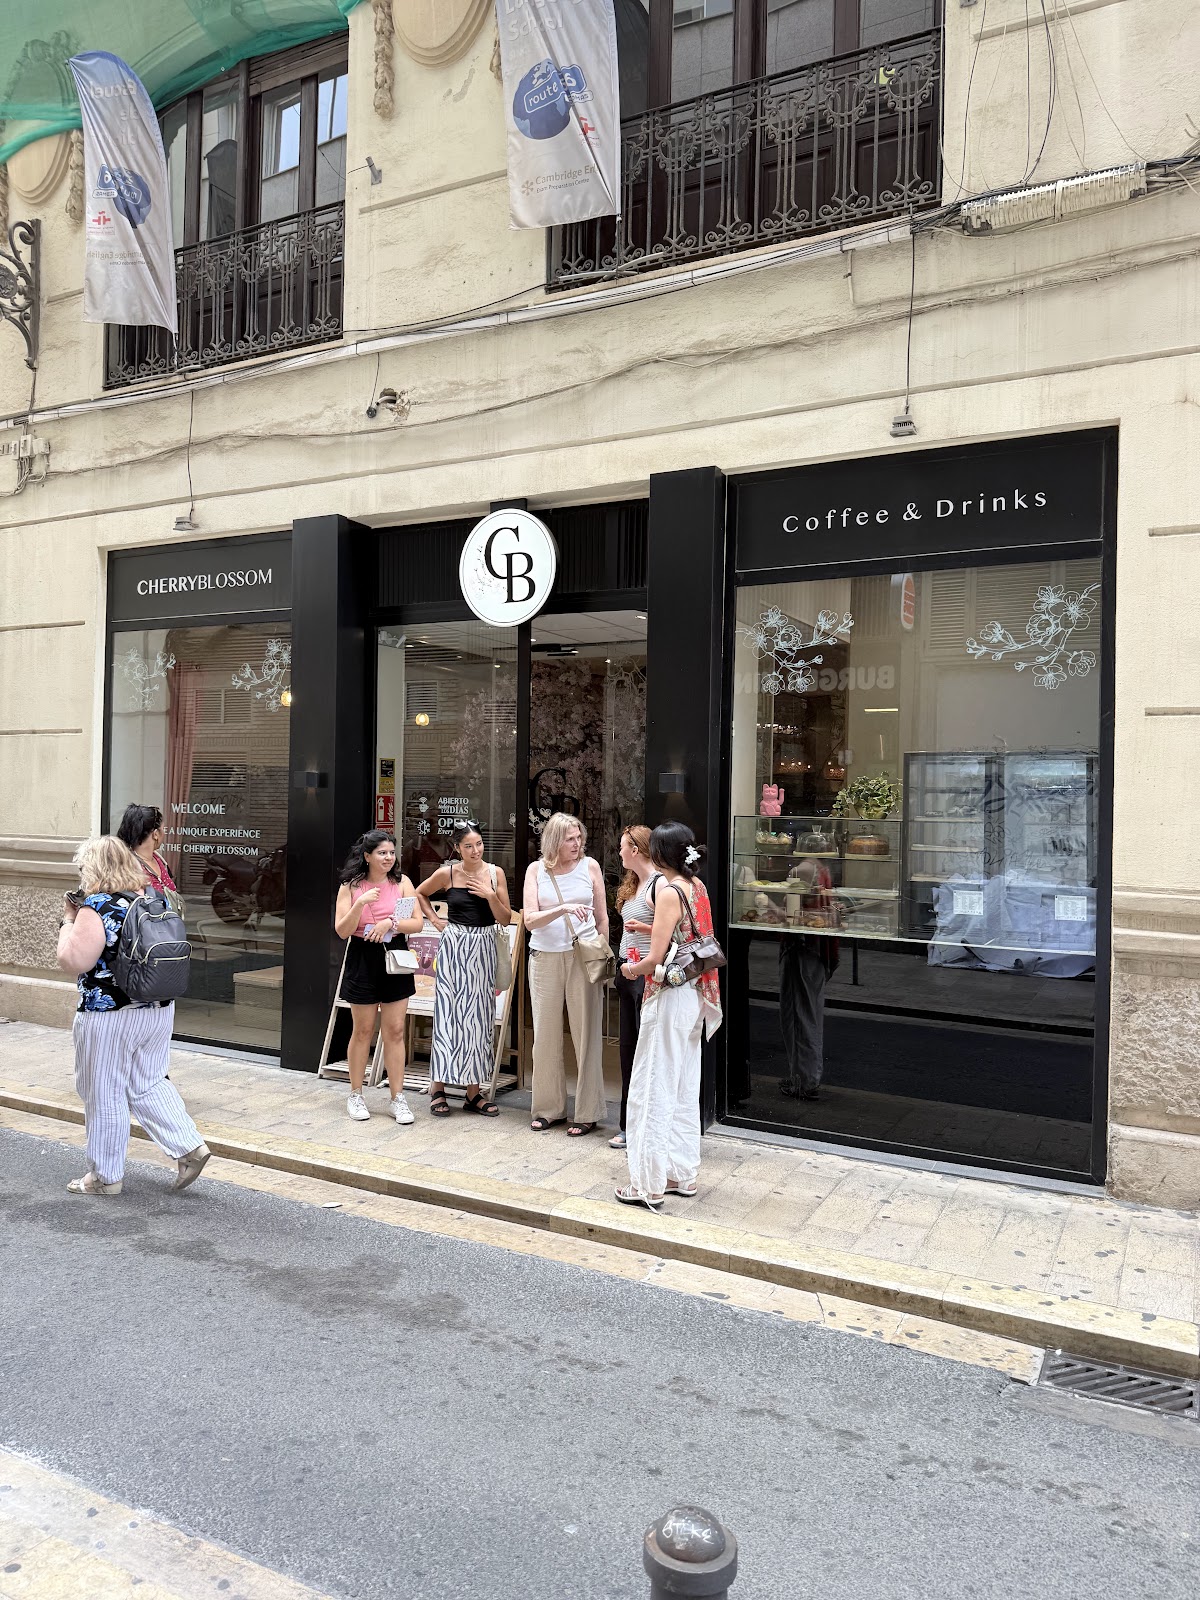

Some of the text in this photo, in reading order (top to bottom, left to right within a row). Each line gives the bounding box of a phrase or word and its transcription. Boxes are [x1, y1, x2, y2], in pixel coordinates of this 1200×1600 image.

[528, 81, 559, 107] route
[535, 169, 583, 184] Cambridge
[782, 488, 1047, 533] Coffee & Drinks
[437, 796, 470, 805] ABIERTO
[171, 802, 226, 815] WELCOME
[176, 826, 208, 838] UNIQUE
[209, 828, 261, 839] EXPERIENCE
[167, 843, 181, 852] THE
[183, 844, 217, 854] CHERRY
[217, 845, 259, 856] BLOSSOM
